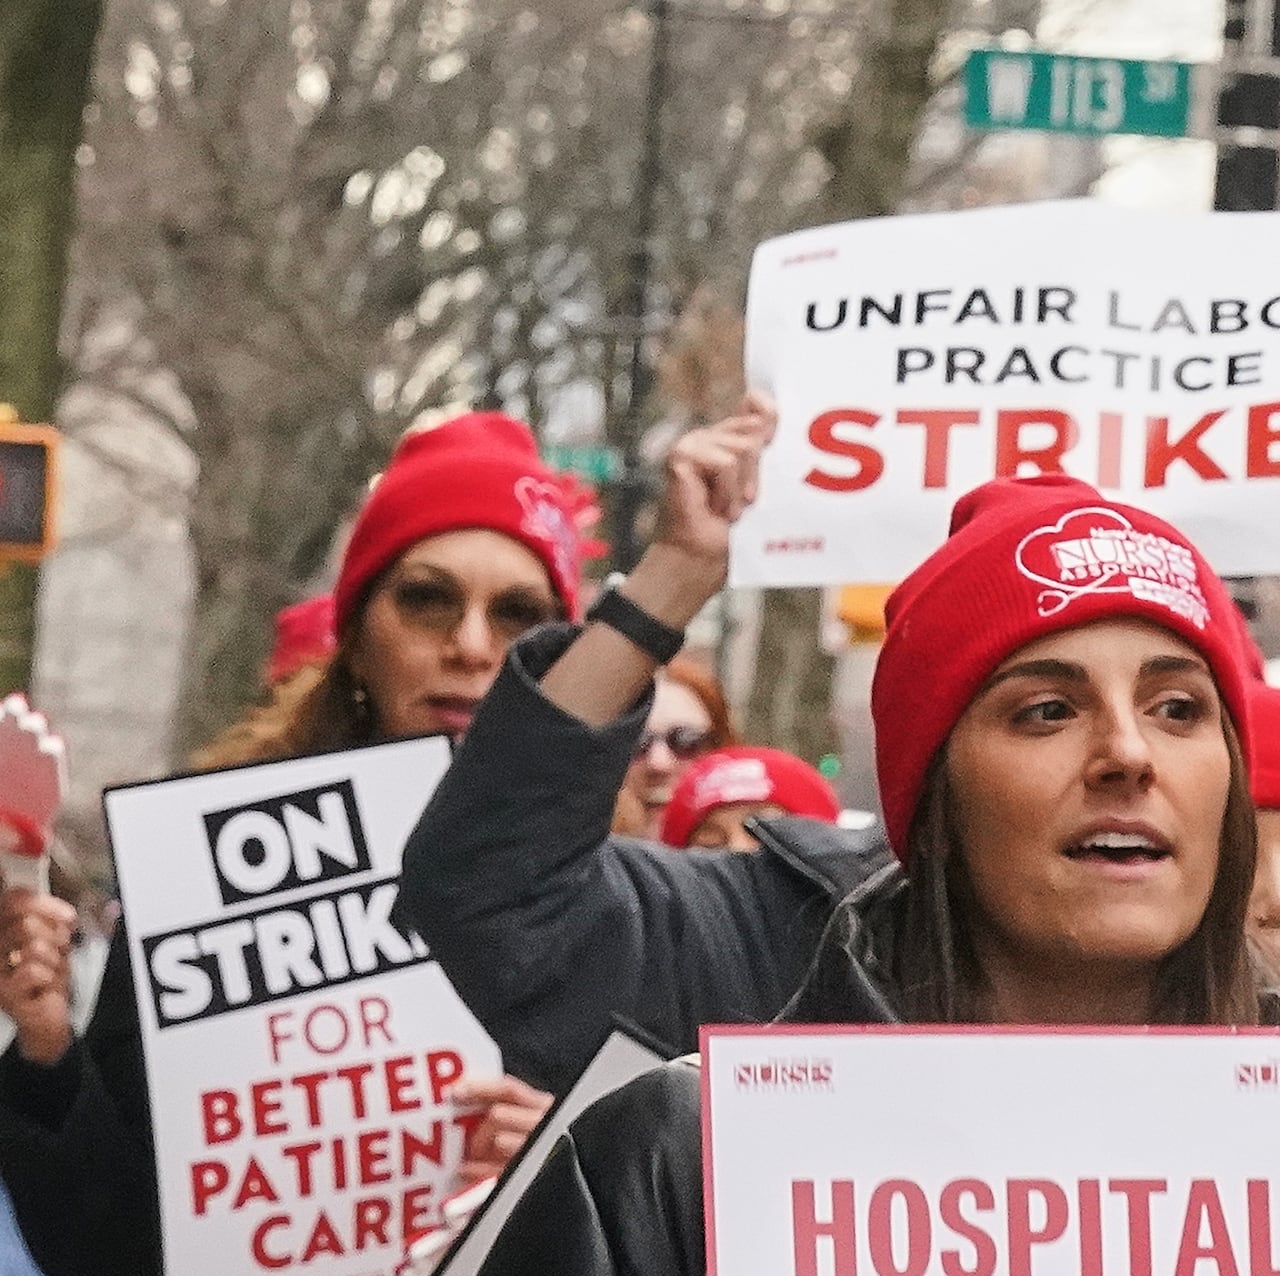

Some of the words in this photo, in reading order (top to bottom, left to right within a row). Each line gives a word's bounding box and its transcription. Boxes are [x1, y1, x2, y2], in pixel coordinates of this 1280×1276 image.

[804, 286, 1079, 332] UNFAIR
[895, 345, 1265, 393] PRACTICE
[1051, 537, 1196, 582] NURSES
[214, 790, 358, 894] ON
[150, 883, 431, 1021] STRIK
[267, 994, 394, 1065] FOR
[250, 1184, 446, 1271] CARE
